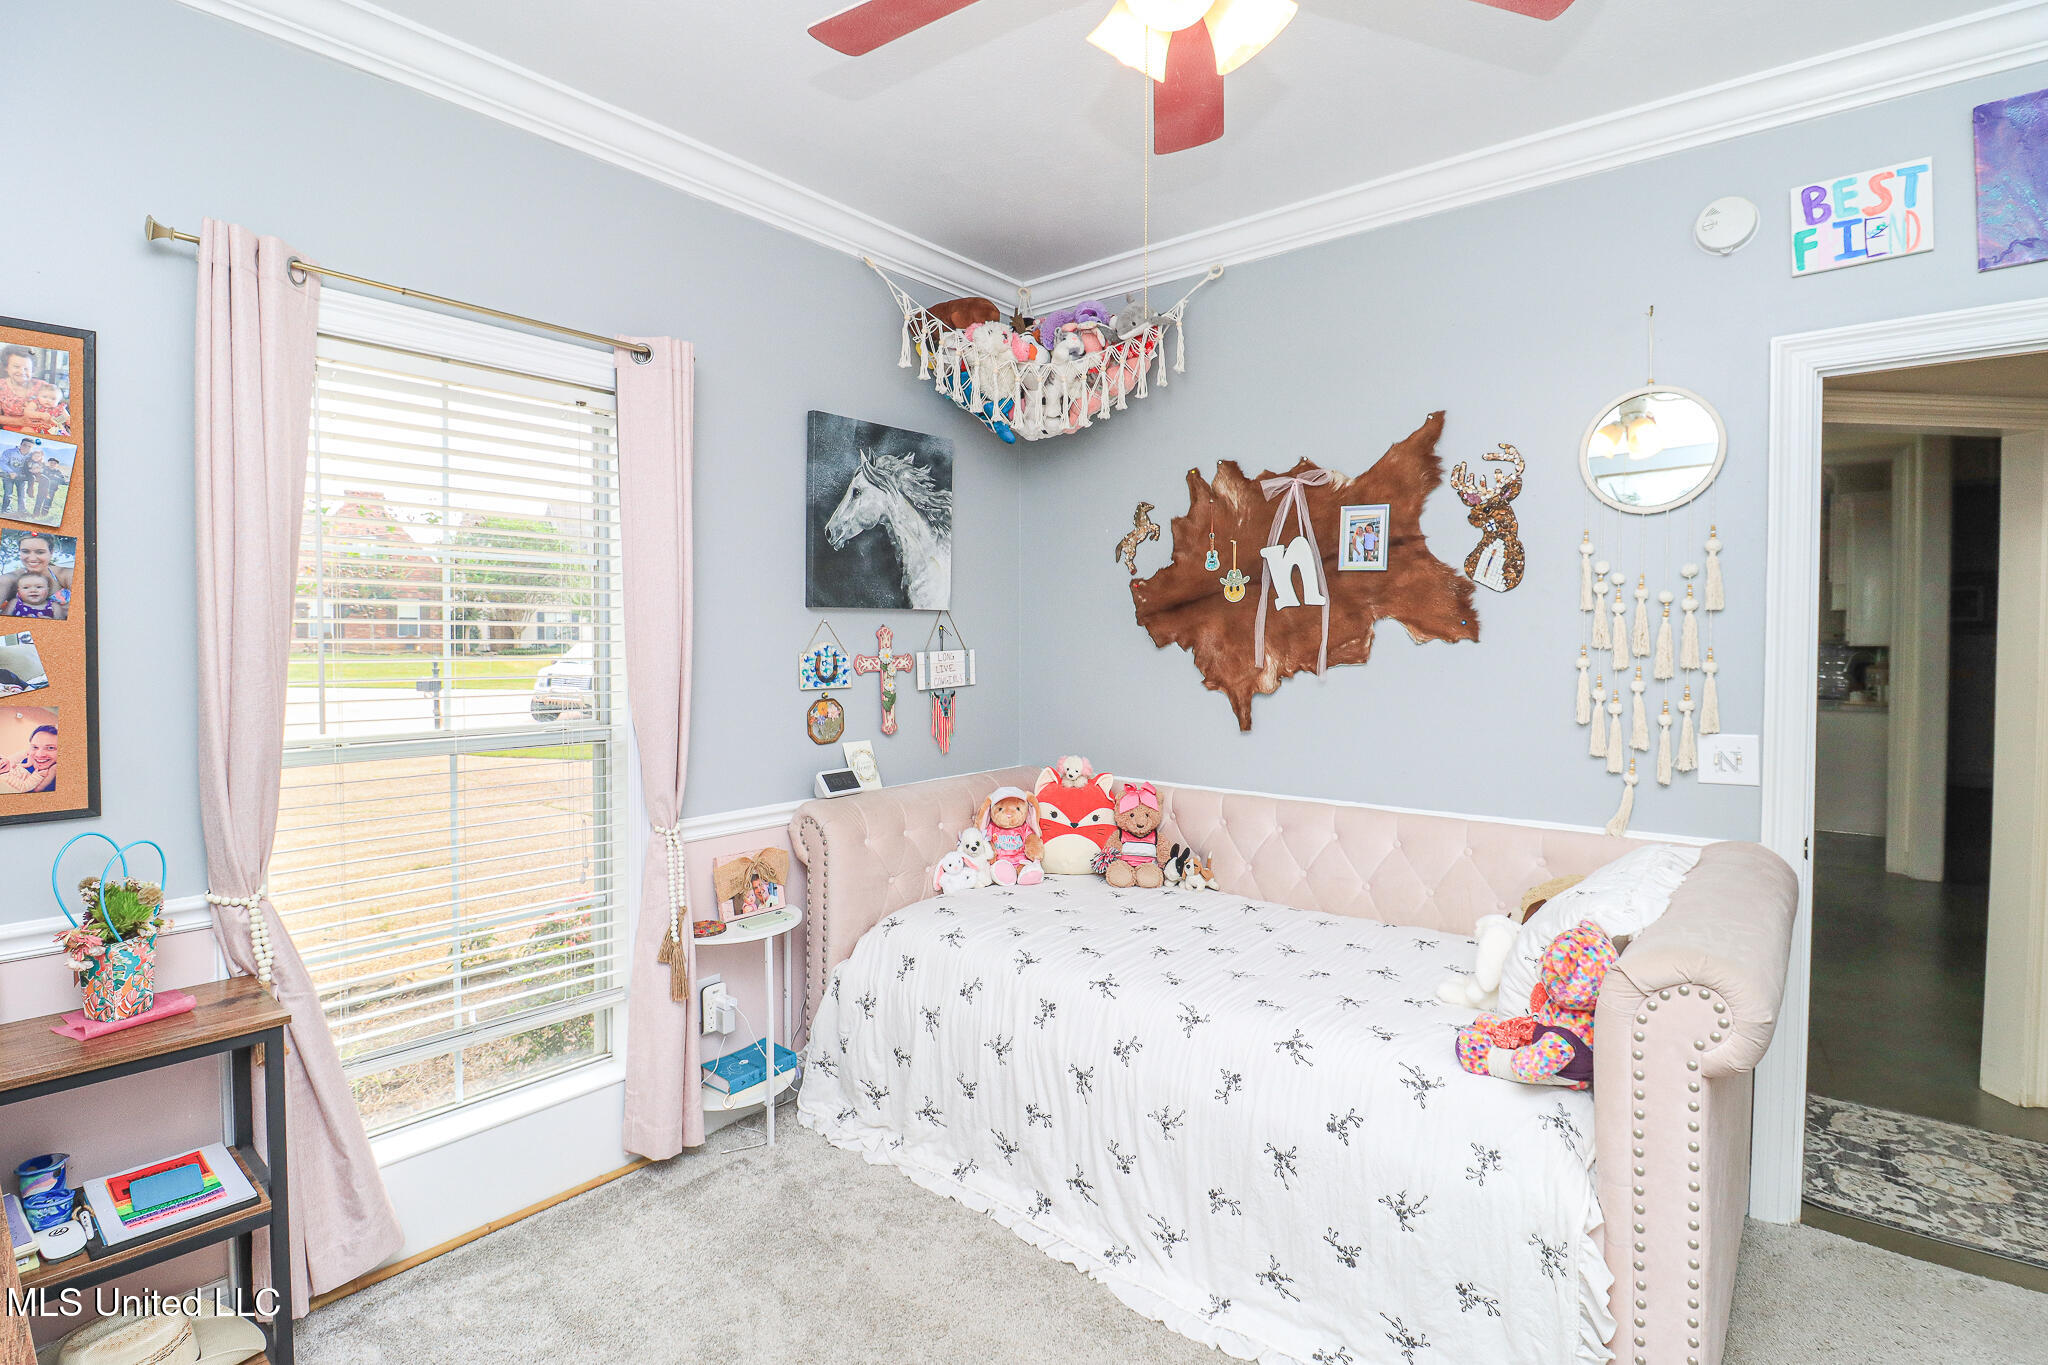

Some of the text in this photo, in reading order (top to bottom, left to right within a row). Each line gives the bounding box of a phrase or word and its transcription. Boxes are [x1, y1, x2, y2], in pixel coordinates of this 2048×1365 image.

[1801, 164, 1929, 226] BEST
[1260, 535, 1326, 611] n
[935, 664, 956, 674] LIVE
